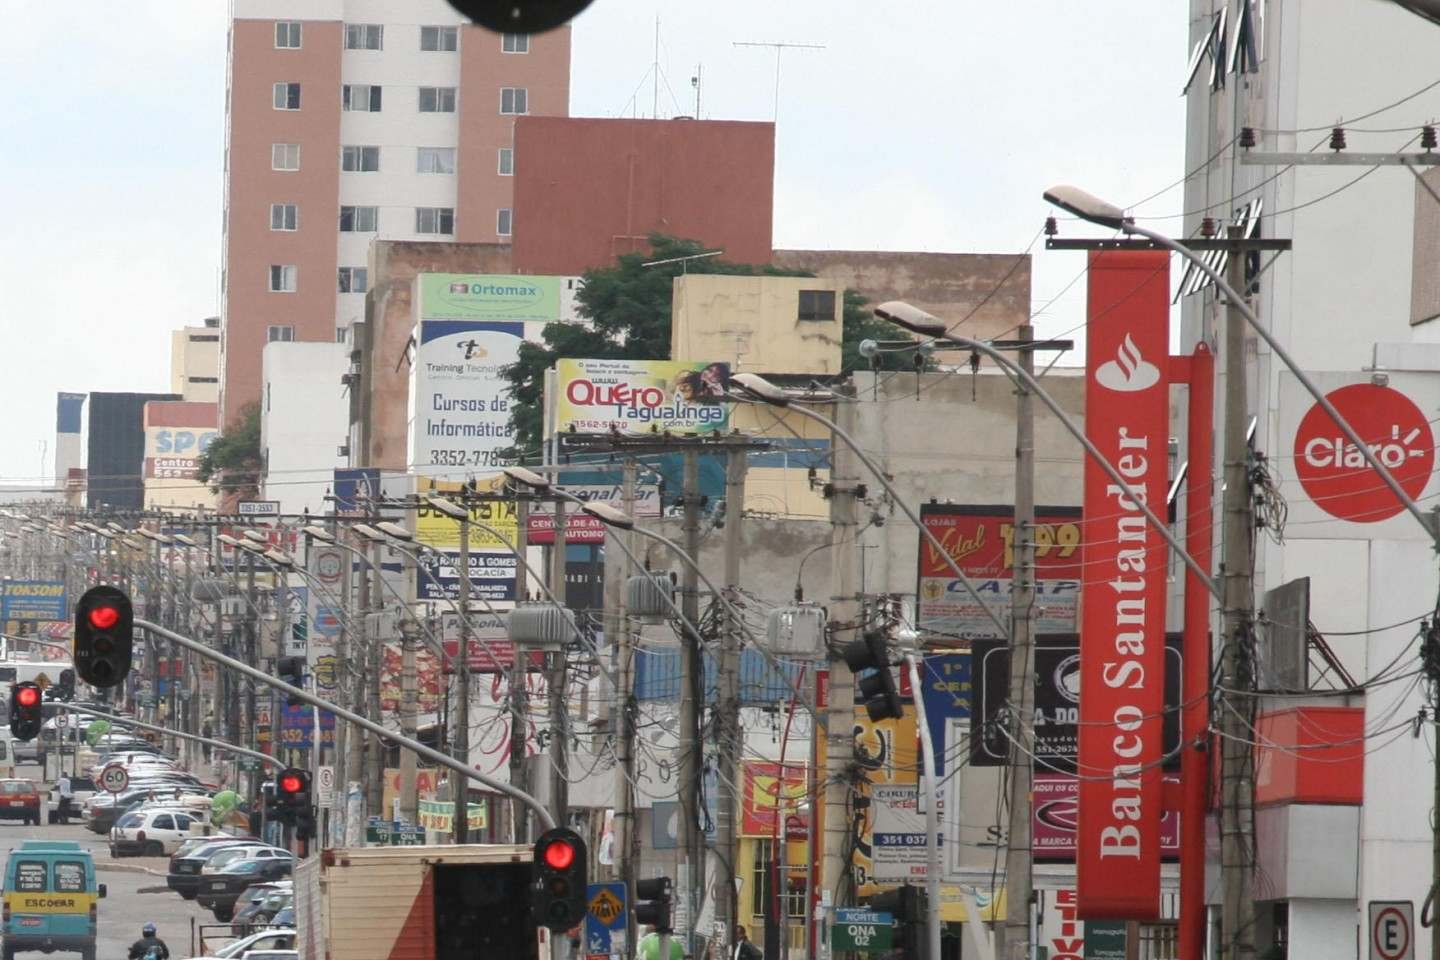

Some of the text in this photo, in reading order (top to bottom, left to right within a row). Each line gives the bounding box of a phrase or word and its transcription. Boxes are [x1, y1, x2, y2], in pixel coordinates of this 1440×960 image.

[471, 284, 536, 296] Ortomax
[427, 363, 464, 374] Training
[433, 393, 508, 412] Cursos de
[427, 419, 512, 438] Informática
[1304, 436, 1407, 469] Claro
[154, 459, 194, 467] Centro
[1104, 426, 1148, 689] Santander
[1100, 705, 1144, 861] Banco
[845, 912, 879, 922] NORTE
[847, 925, 877, 938] QNA
[1385, 919, 1398, 951] E
[854, 935, 871, 946] 02
